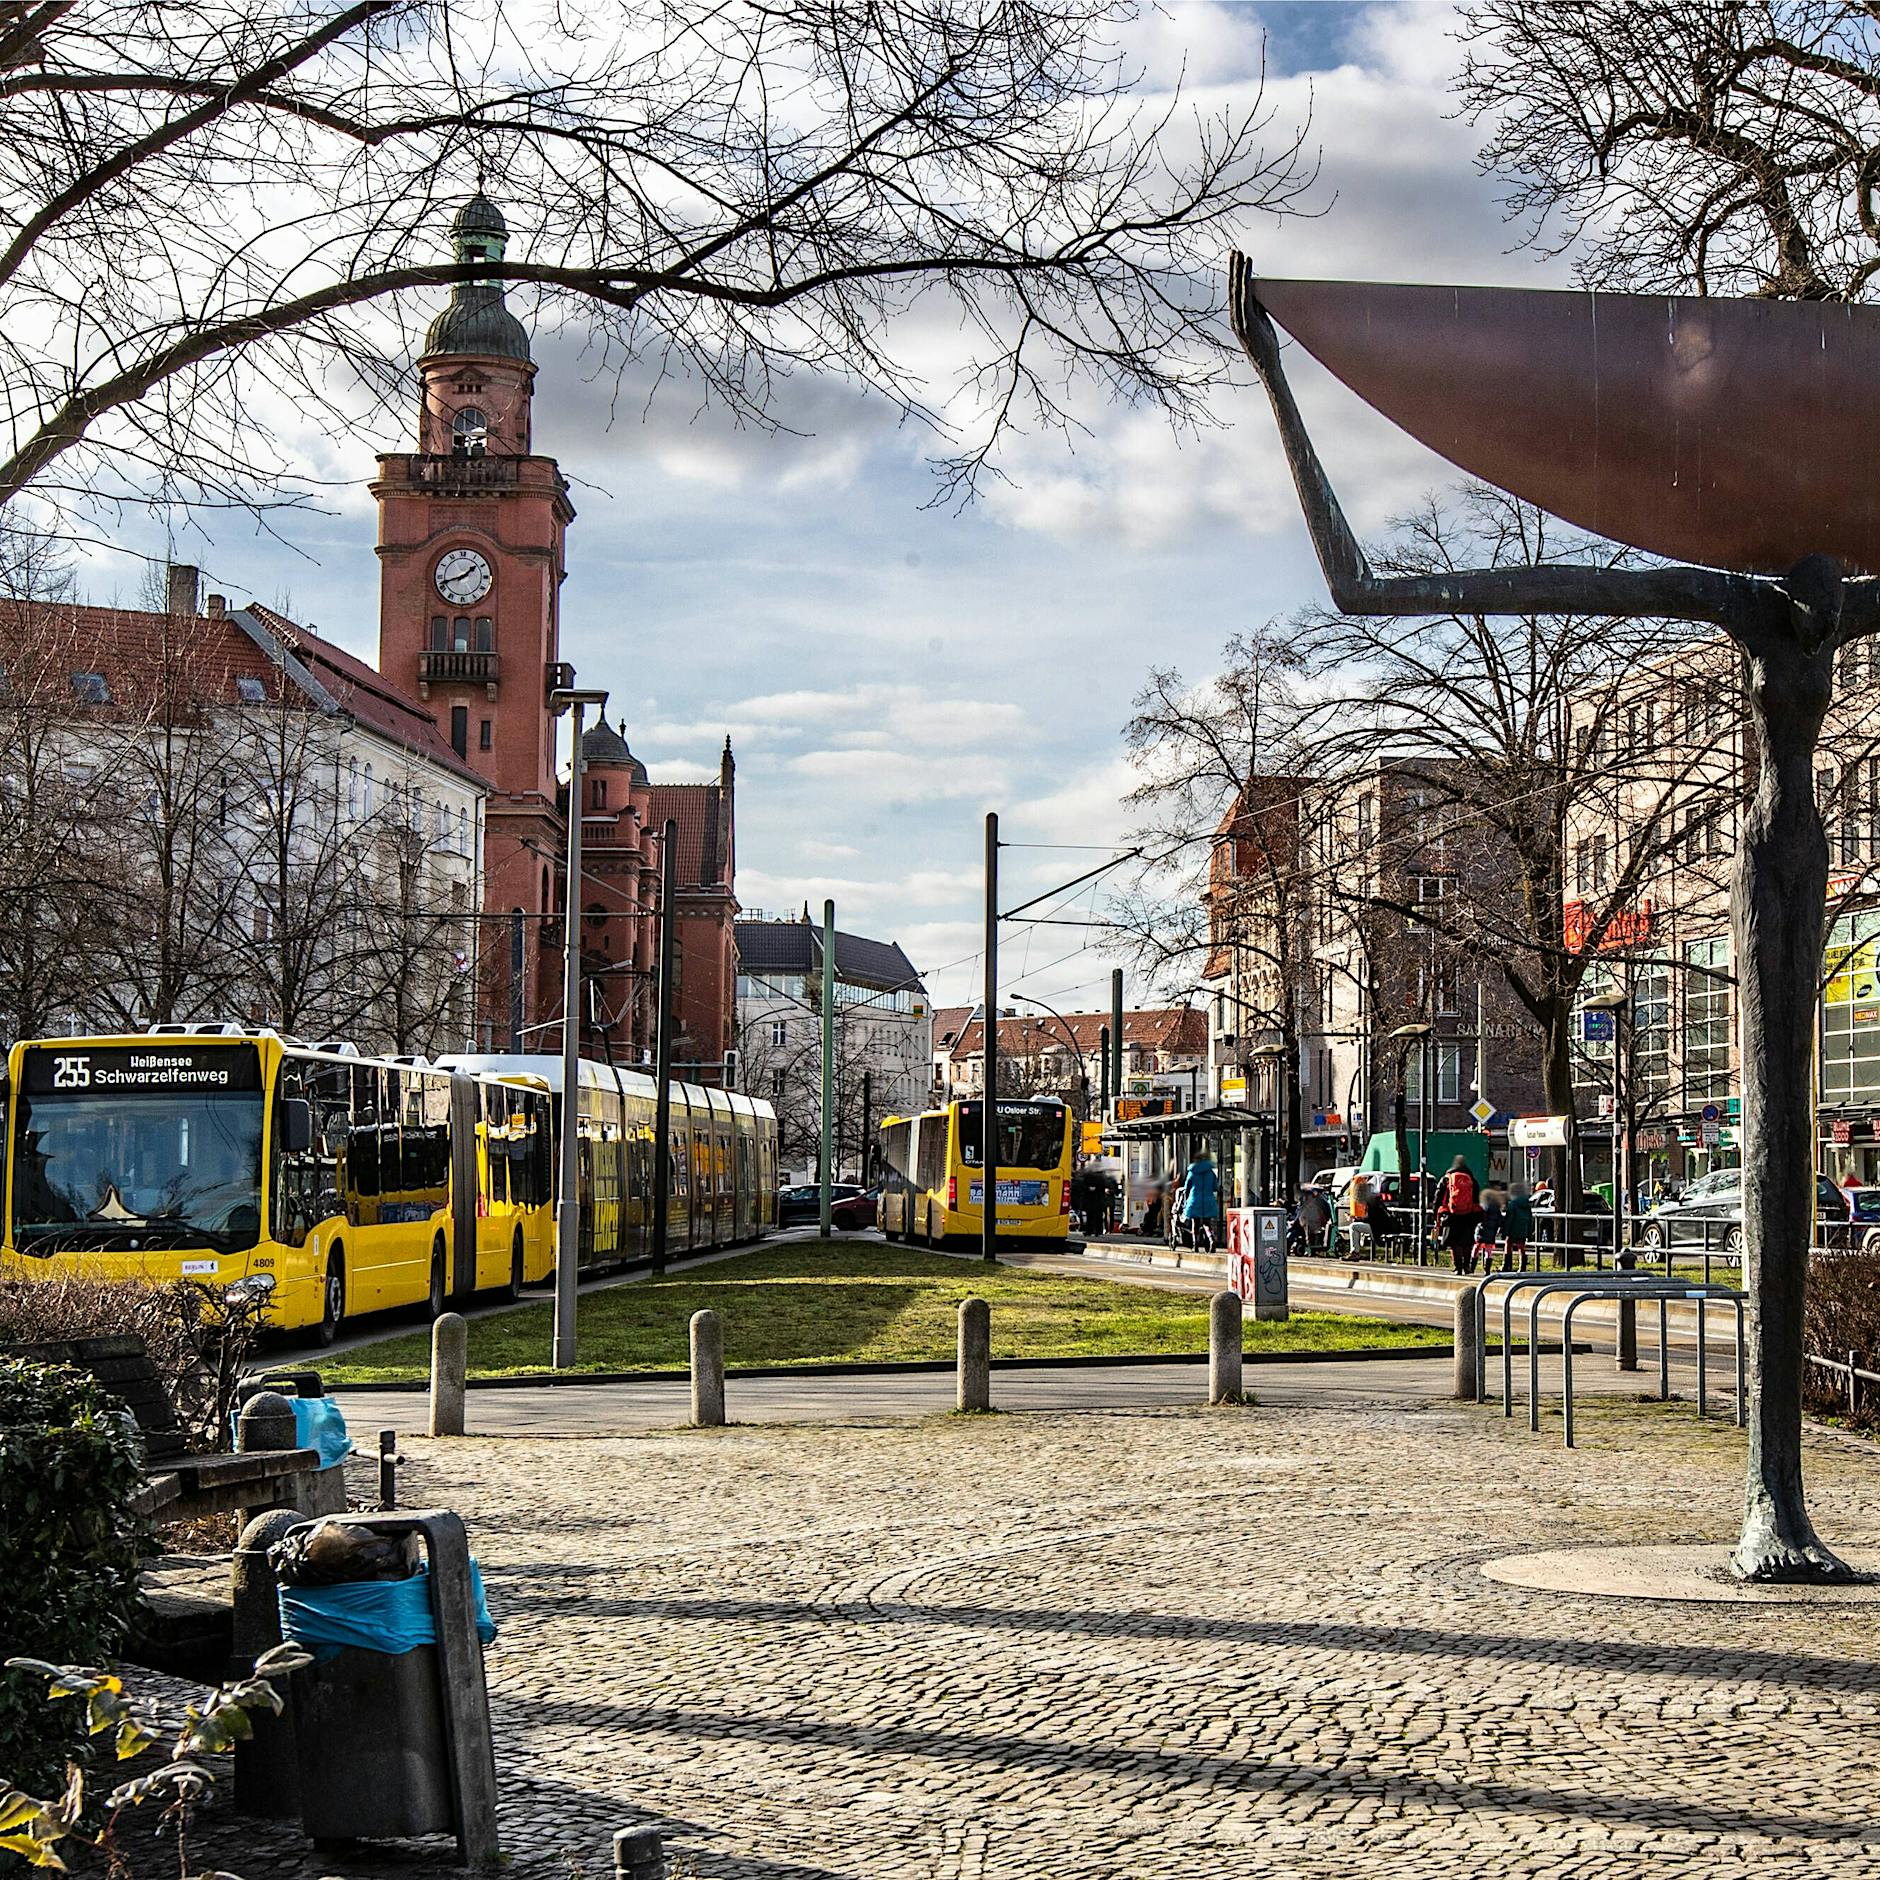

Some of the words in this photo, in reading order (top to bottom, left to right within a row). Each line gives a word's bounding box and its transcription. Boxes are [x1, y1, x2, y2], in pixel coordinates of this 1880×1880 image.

[130, 1055, 192, 1068] Weißensee
[53, 1057, 91, 1088] 255
[94, 1069, 228, 1085] Schwarzelfenweg
[997, 1106, 1003, 1114] U
[1004, 1106, 1027, 1115] Osloer
[1028, 1106, 1041, 1115] Str.
[1637, 1131, 1664, 1150] theke
[253, 1258, 275, 1268] 4809
